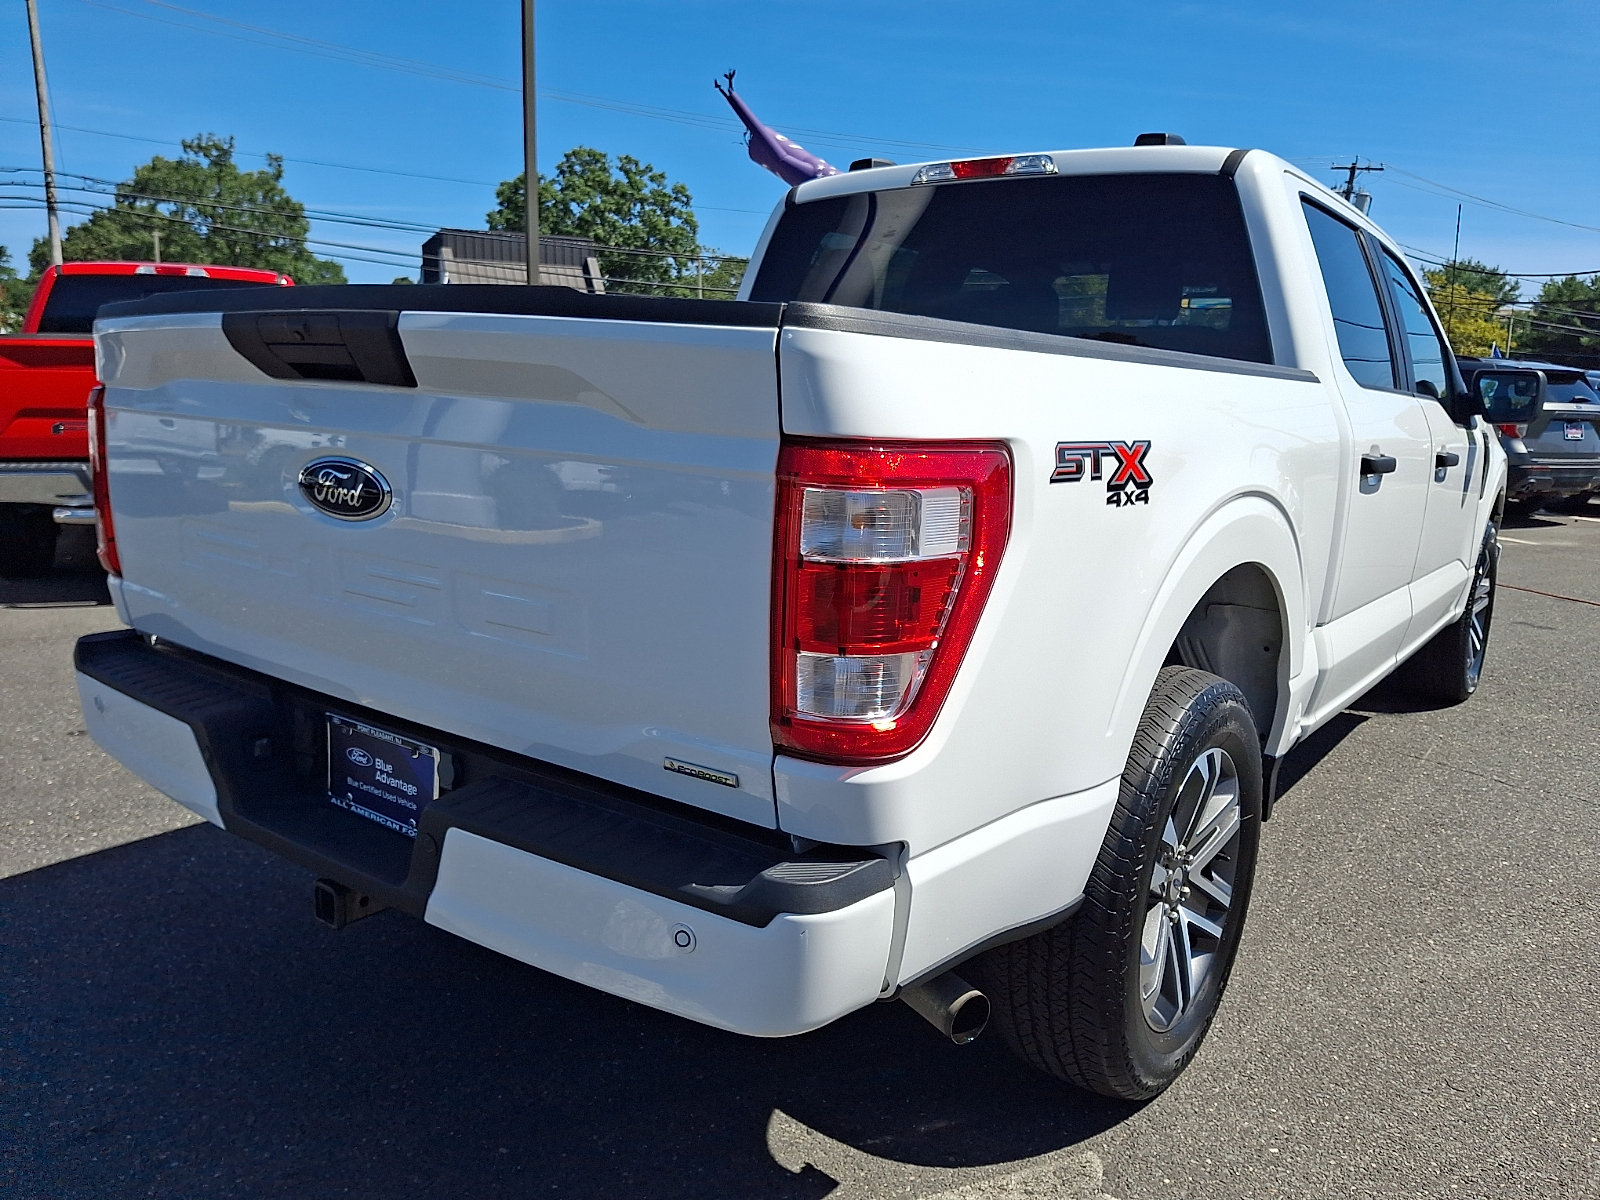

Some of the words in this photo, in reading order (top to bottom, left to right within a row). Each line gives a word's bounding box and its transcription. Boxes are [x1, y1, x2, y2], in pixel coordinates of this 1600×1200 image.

[1049, 440, 1154, 492] STX
[314, 469, 363, 508] Ford
[375, 758, 393, 773] Blue
[375, 771, 418, 795] Advantage
[347, 776, 359, 788] Blue
[359, 782, 382, 797] Certified
[382, 790, 397, 803] Used
[397, 795, 418, 811] Vehicle
[330, 797, 349, 809] ALL
[350, 806, 400, 832] AMERICAN
